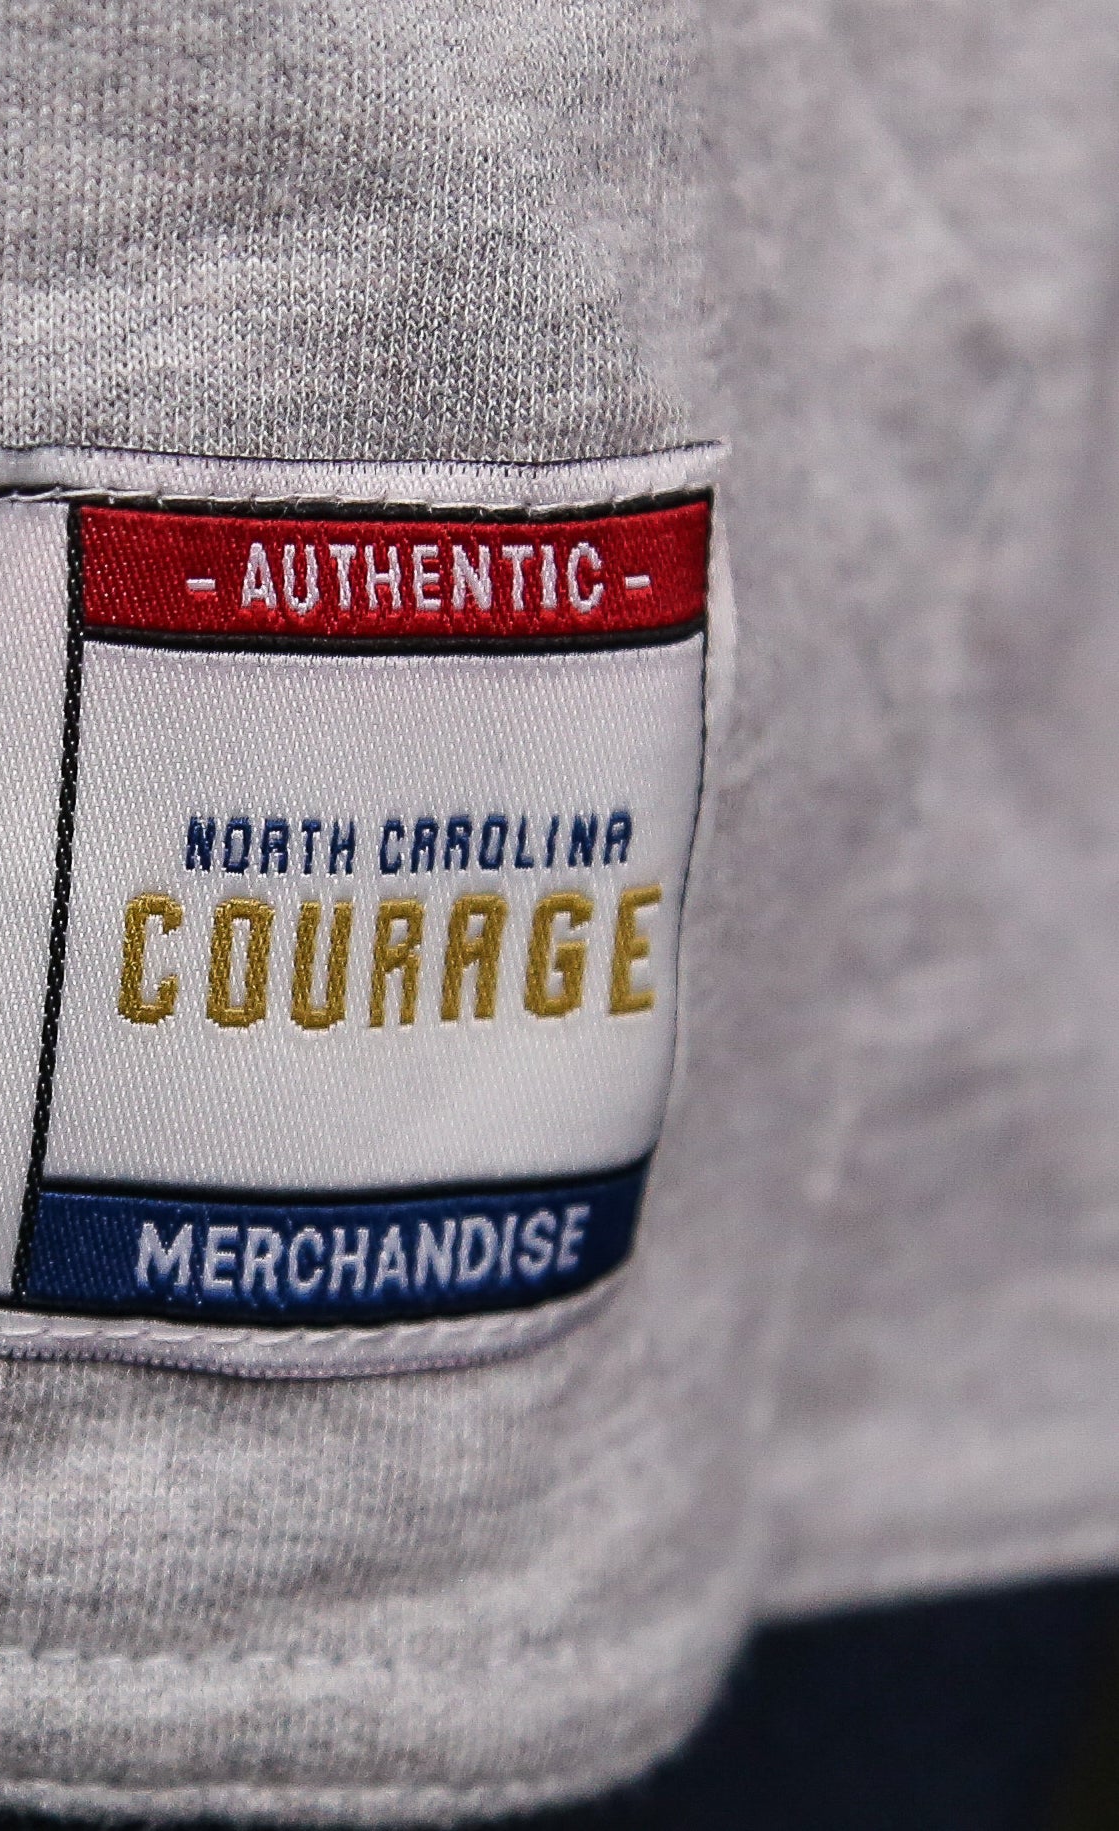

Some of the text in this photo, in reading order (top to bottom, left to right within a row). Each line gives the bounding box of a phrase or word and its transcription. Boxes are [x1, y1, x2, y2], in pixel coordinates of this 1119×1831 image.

[240, 542, 605, 613] AUTHENTIC
[185, 809, 634, 875] NORTH CAROLINA
[117, 884, 663, 1030] COURAGE
[135, 1205, 591, 1297] MERCHANDISE
